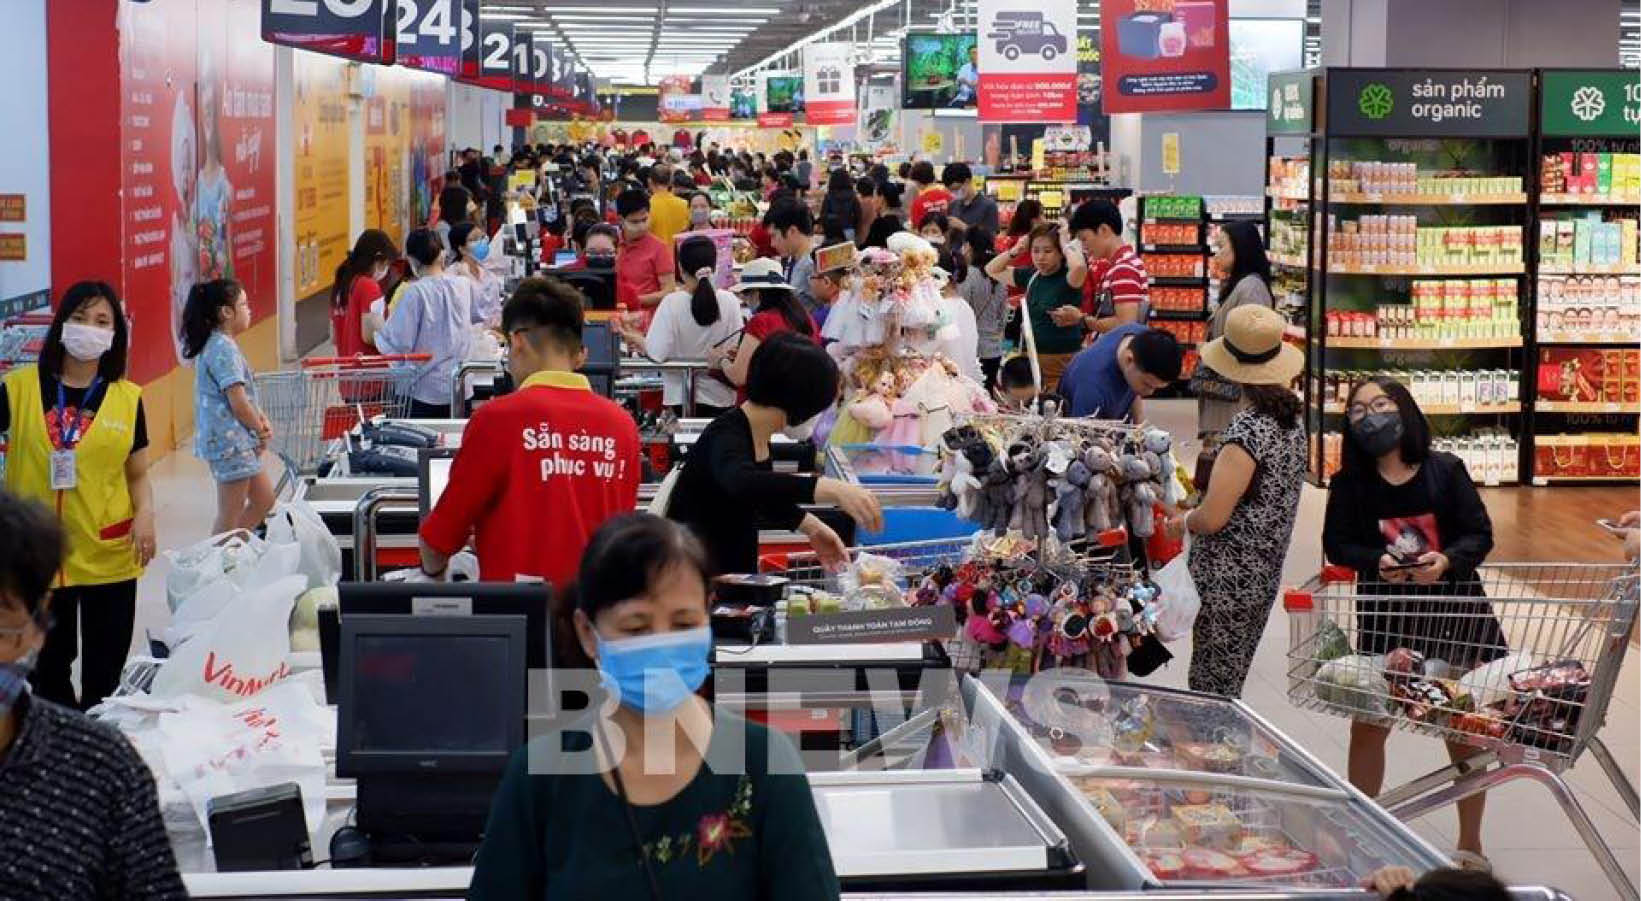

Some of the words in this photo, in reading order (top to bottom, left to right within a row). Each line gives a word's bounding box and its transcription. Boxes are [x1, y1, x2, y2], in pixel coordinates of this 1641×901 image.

[1412, 78, 1445, 97] sản
[1451, 76, 1505, 101] phẩm
[1411, 101, 1482, 122] organic
[569, 428, 616, 460] sàng
[593, 460, 615, 483] vụ
